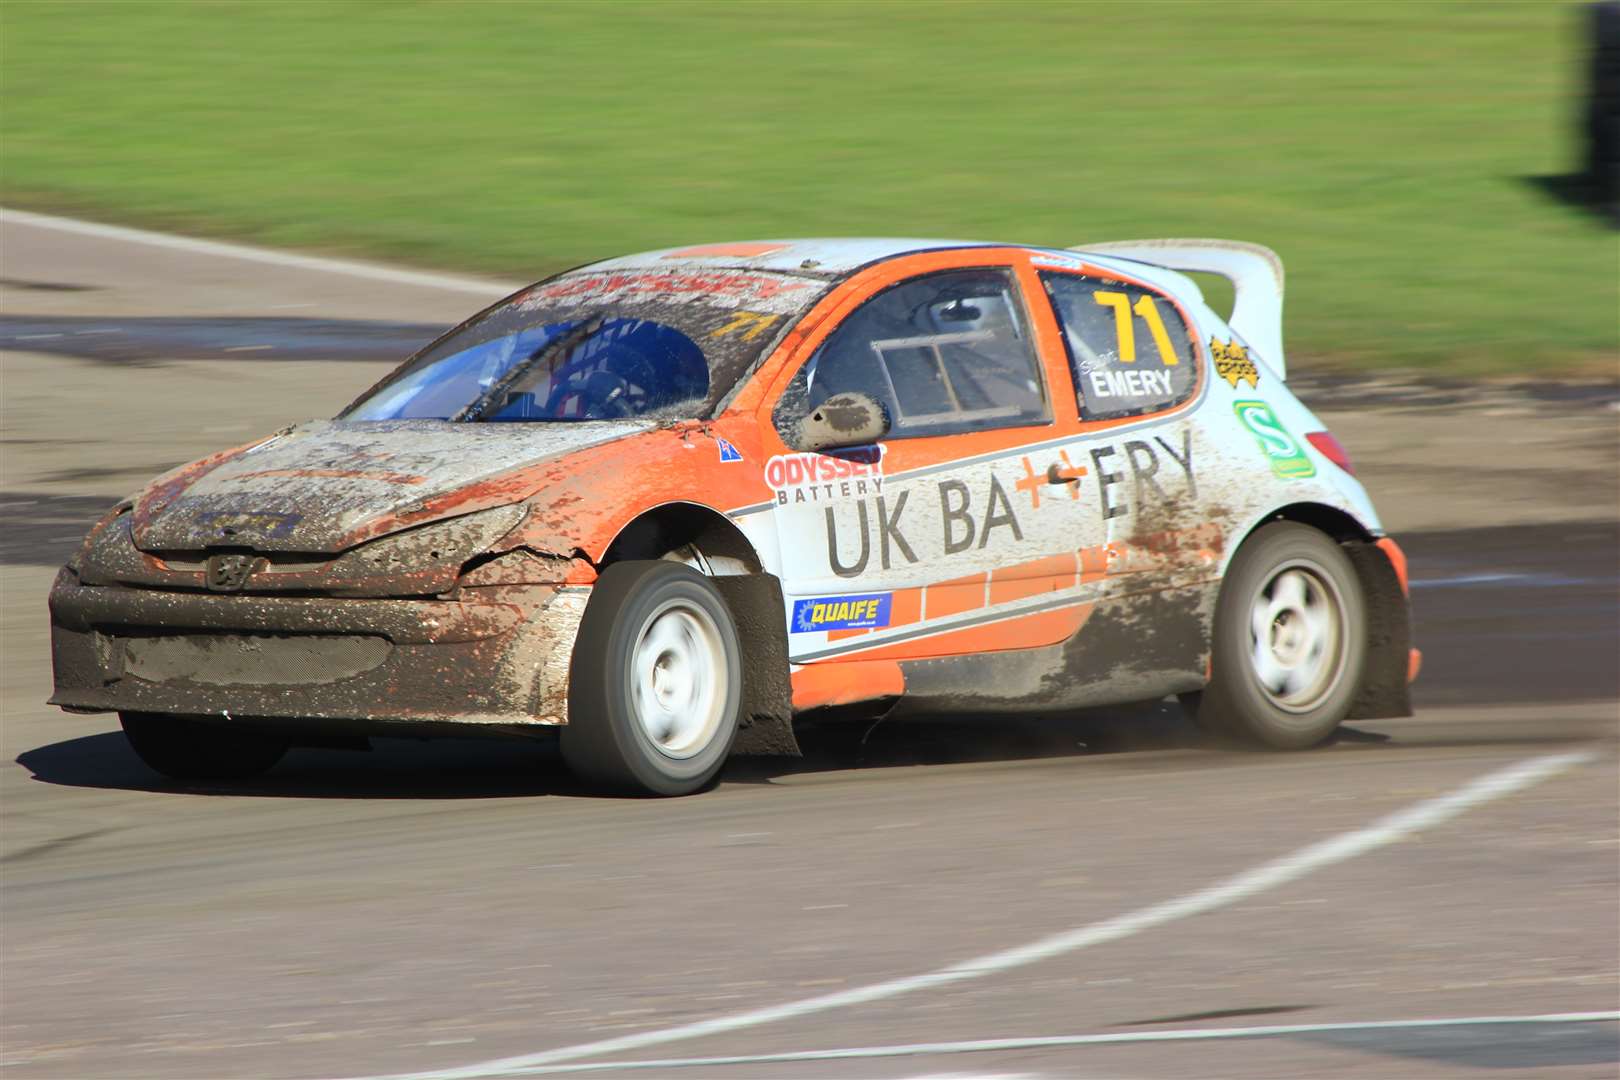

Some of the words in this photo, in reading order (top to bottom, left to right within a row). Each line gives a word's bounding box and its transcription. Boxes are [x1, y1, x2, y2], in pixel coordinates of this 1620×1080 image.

[711, 310, 779, 342] 71
[1093, 290, 1179, 366] 71
[1089, 369, 1173, 398] EMERY
[777, 477, 882, 505] BATTERY
[824, 491, 919, 578] UK
[811, 599, 880, 624] QUAIFE
